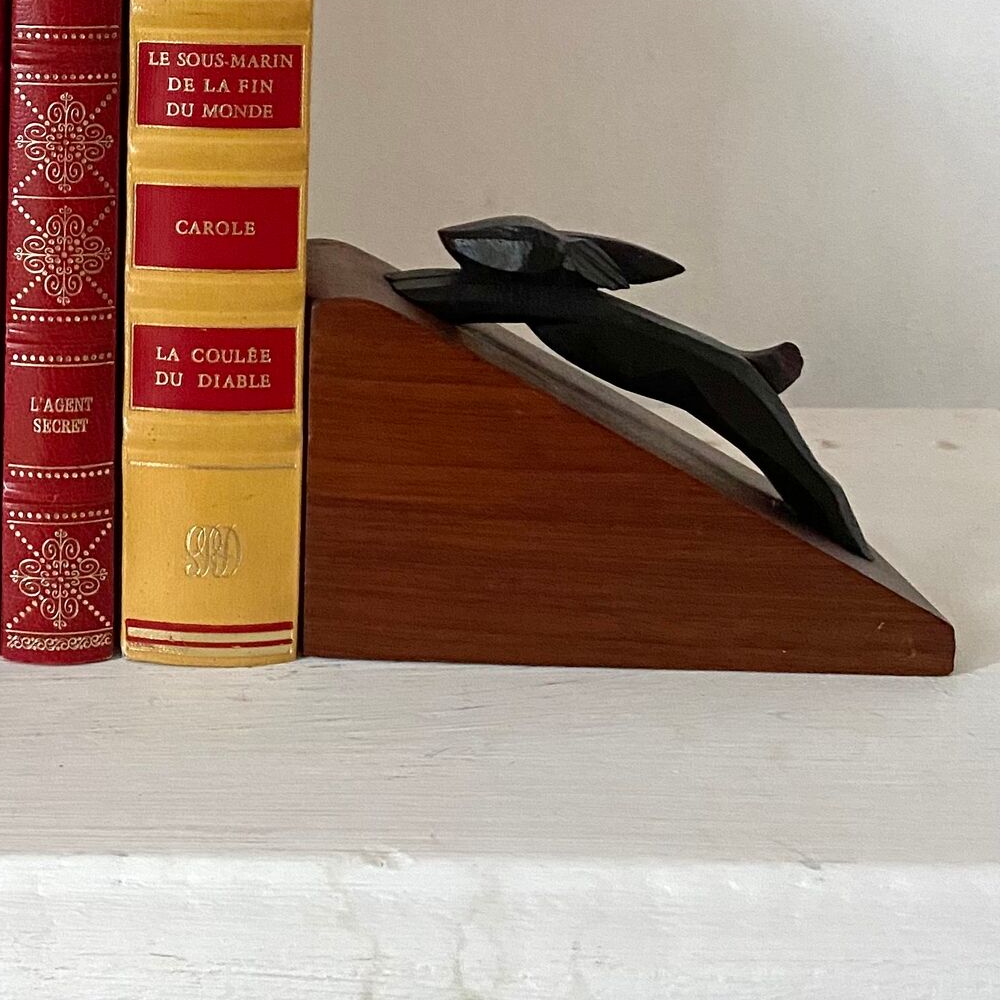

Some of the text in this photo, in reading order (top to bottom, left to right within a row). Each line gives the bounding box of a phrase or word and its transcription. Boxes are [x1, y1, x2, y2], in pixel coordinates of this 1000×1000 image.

[148, 52, 294, 68] LE SOUS-MARIN
[167, 77, 273, 94] DE LA FIN
[166, 102, 274, 118] DU MONDE
[175, 219, 256, 236] CAROLE
[155, 346, 180, 362] LA
[155, 371, 271, 389] DU DIABLE
[30, 396, 94, 413] L'AGENT
[33, 418, 88, 434] SECRET
